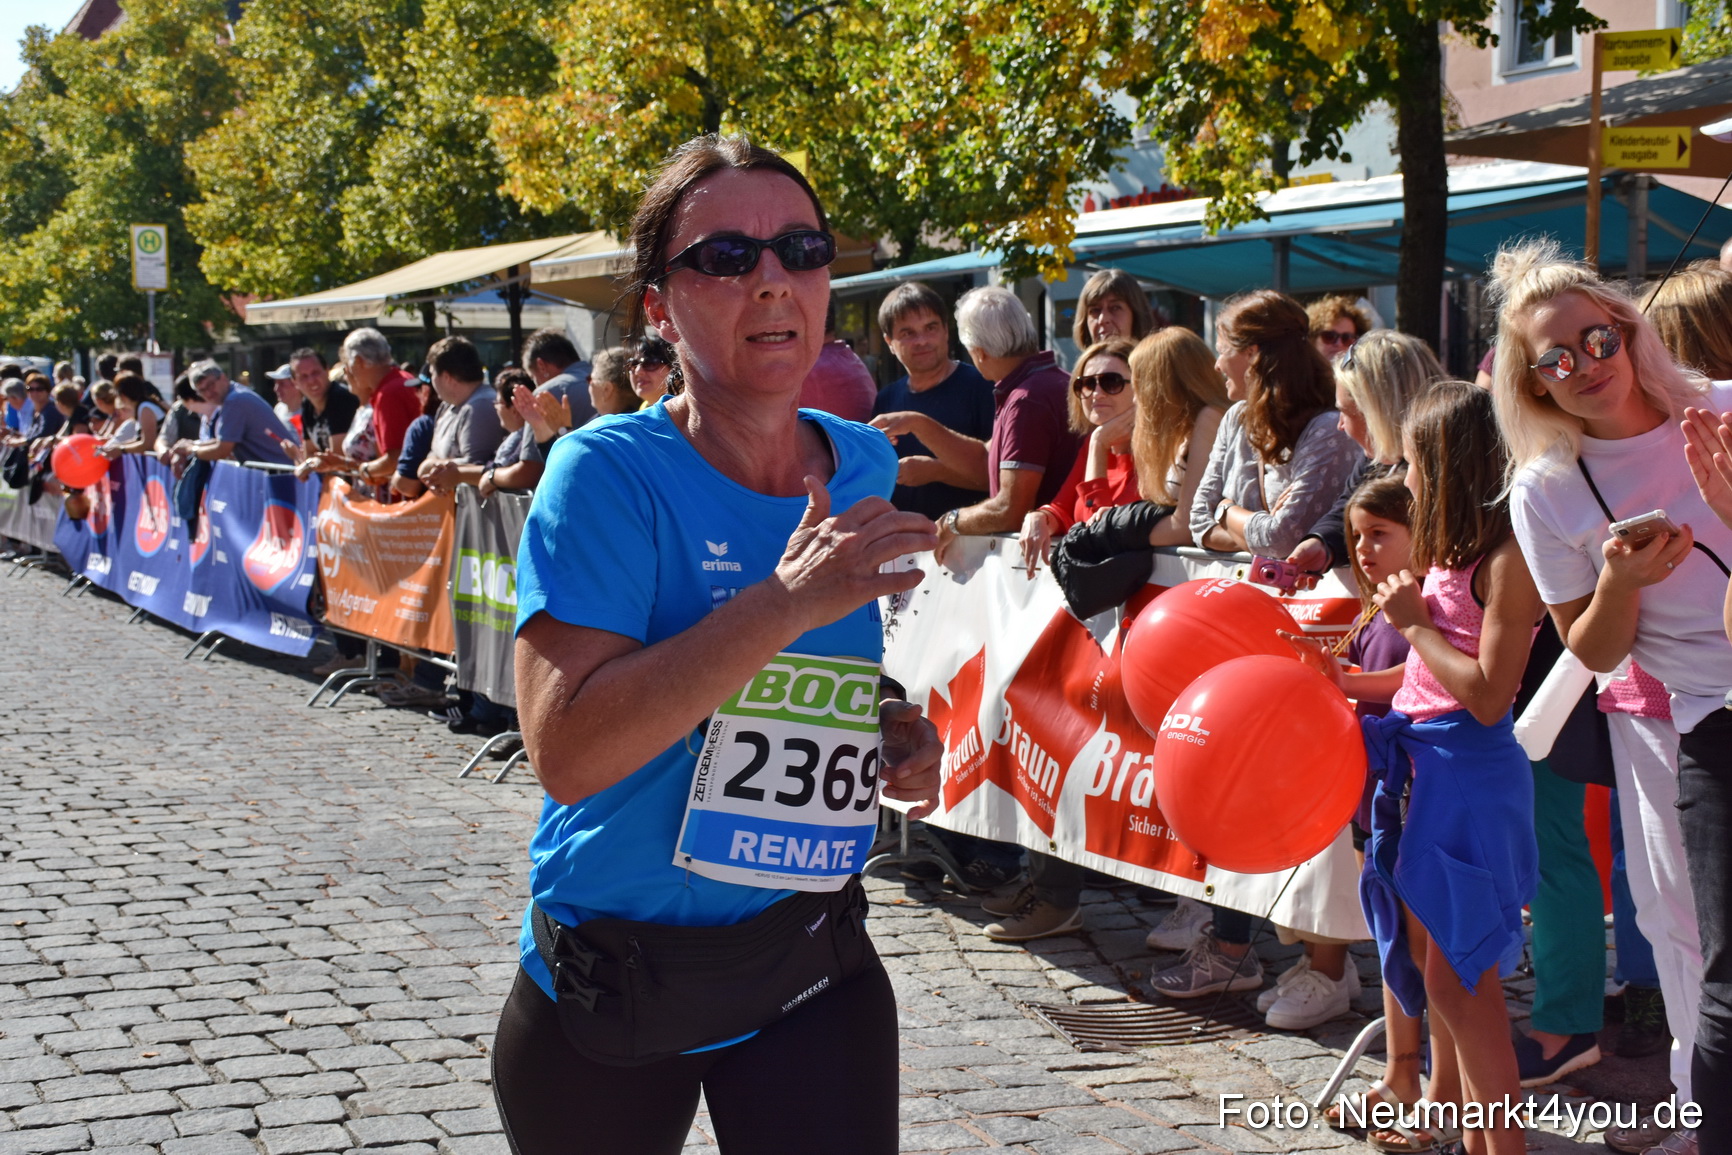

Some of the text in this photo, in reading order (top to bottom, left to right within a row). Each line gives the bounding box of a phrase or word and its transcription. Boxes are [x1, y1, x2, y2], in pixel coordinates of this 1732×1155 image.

[1620, 149, 1658, 162] ausgabe
[456, 549, 518, 612] BOC
[702, 559, 742, 572] erima
[741, 666, 880, 720] BOC
[1090, 670, 1105, 711] Seit 1929
[995, 697, 1060, 799] Braun
[723, 730, 879, 812] 2369
[1016, 768, 1031, 794] Sicher
[1029, 785, 1039, 802] ist
[1084, 728, 1161, 810] Bra
[1128, 813, 1179, 842] Sicher is
[728, 829, 857, 870] RENATE
[781, 976, 829, 1011] VANBEEKEN
